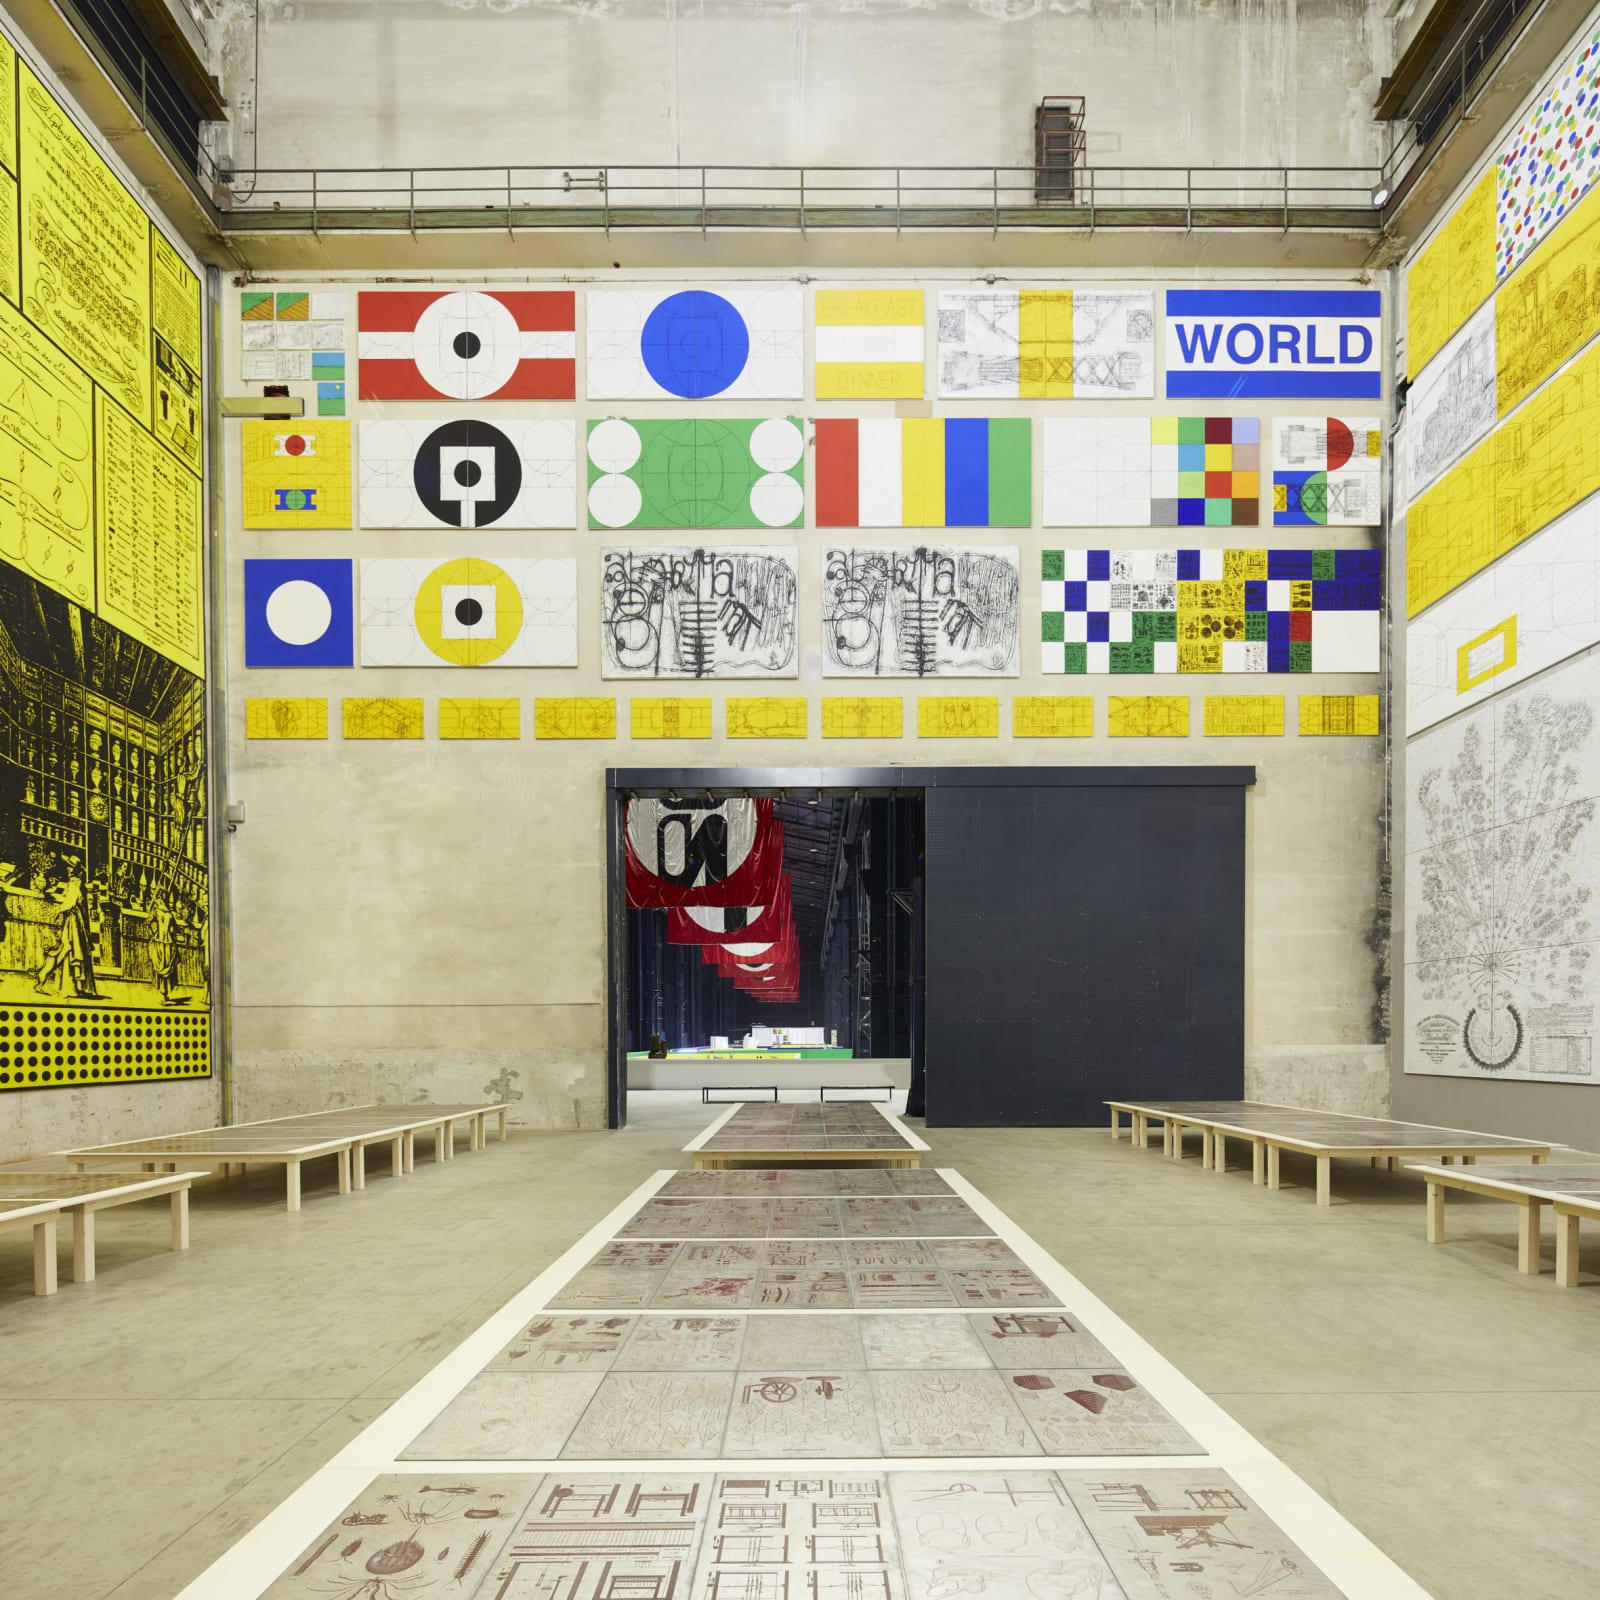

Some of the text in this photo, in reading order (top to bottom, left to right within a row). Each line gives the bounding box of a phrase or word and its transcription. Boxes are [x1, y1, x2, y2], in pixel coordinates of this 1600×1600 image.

[822, 297, 917, 319] BREAKFAST
[1175, 323, 1373, 365] WORLD
[838, 370, 902, 391] DINNER
